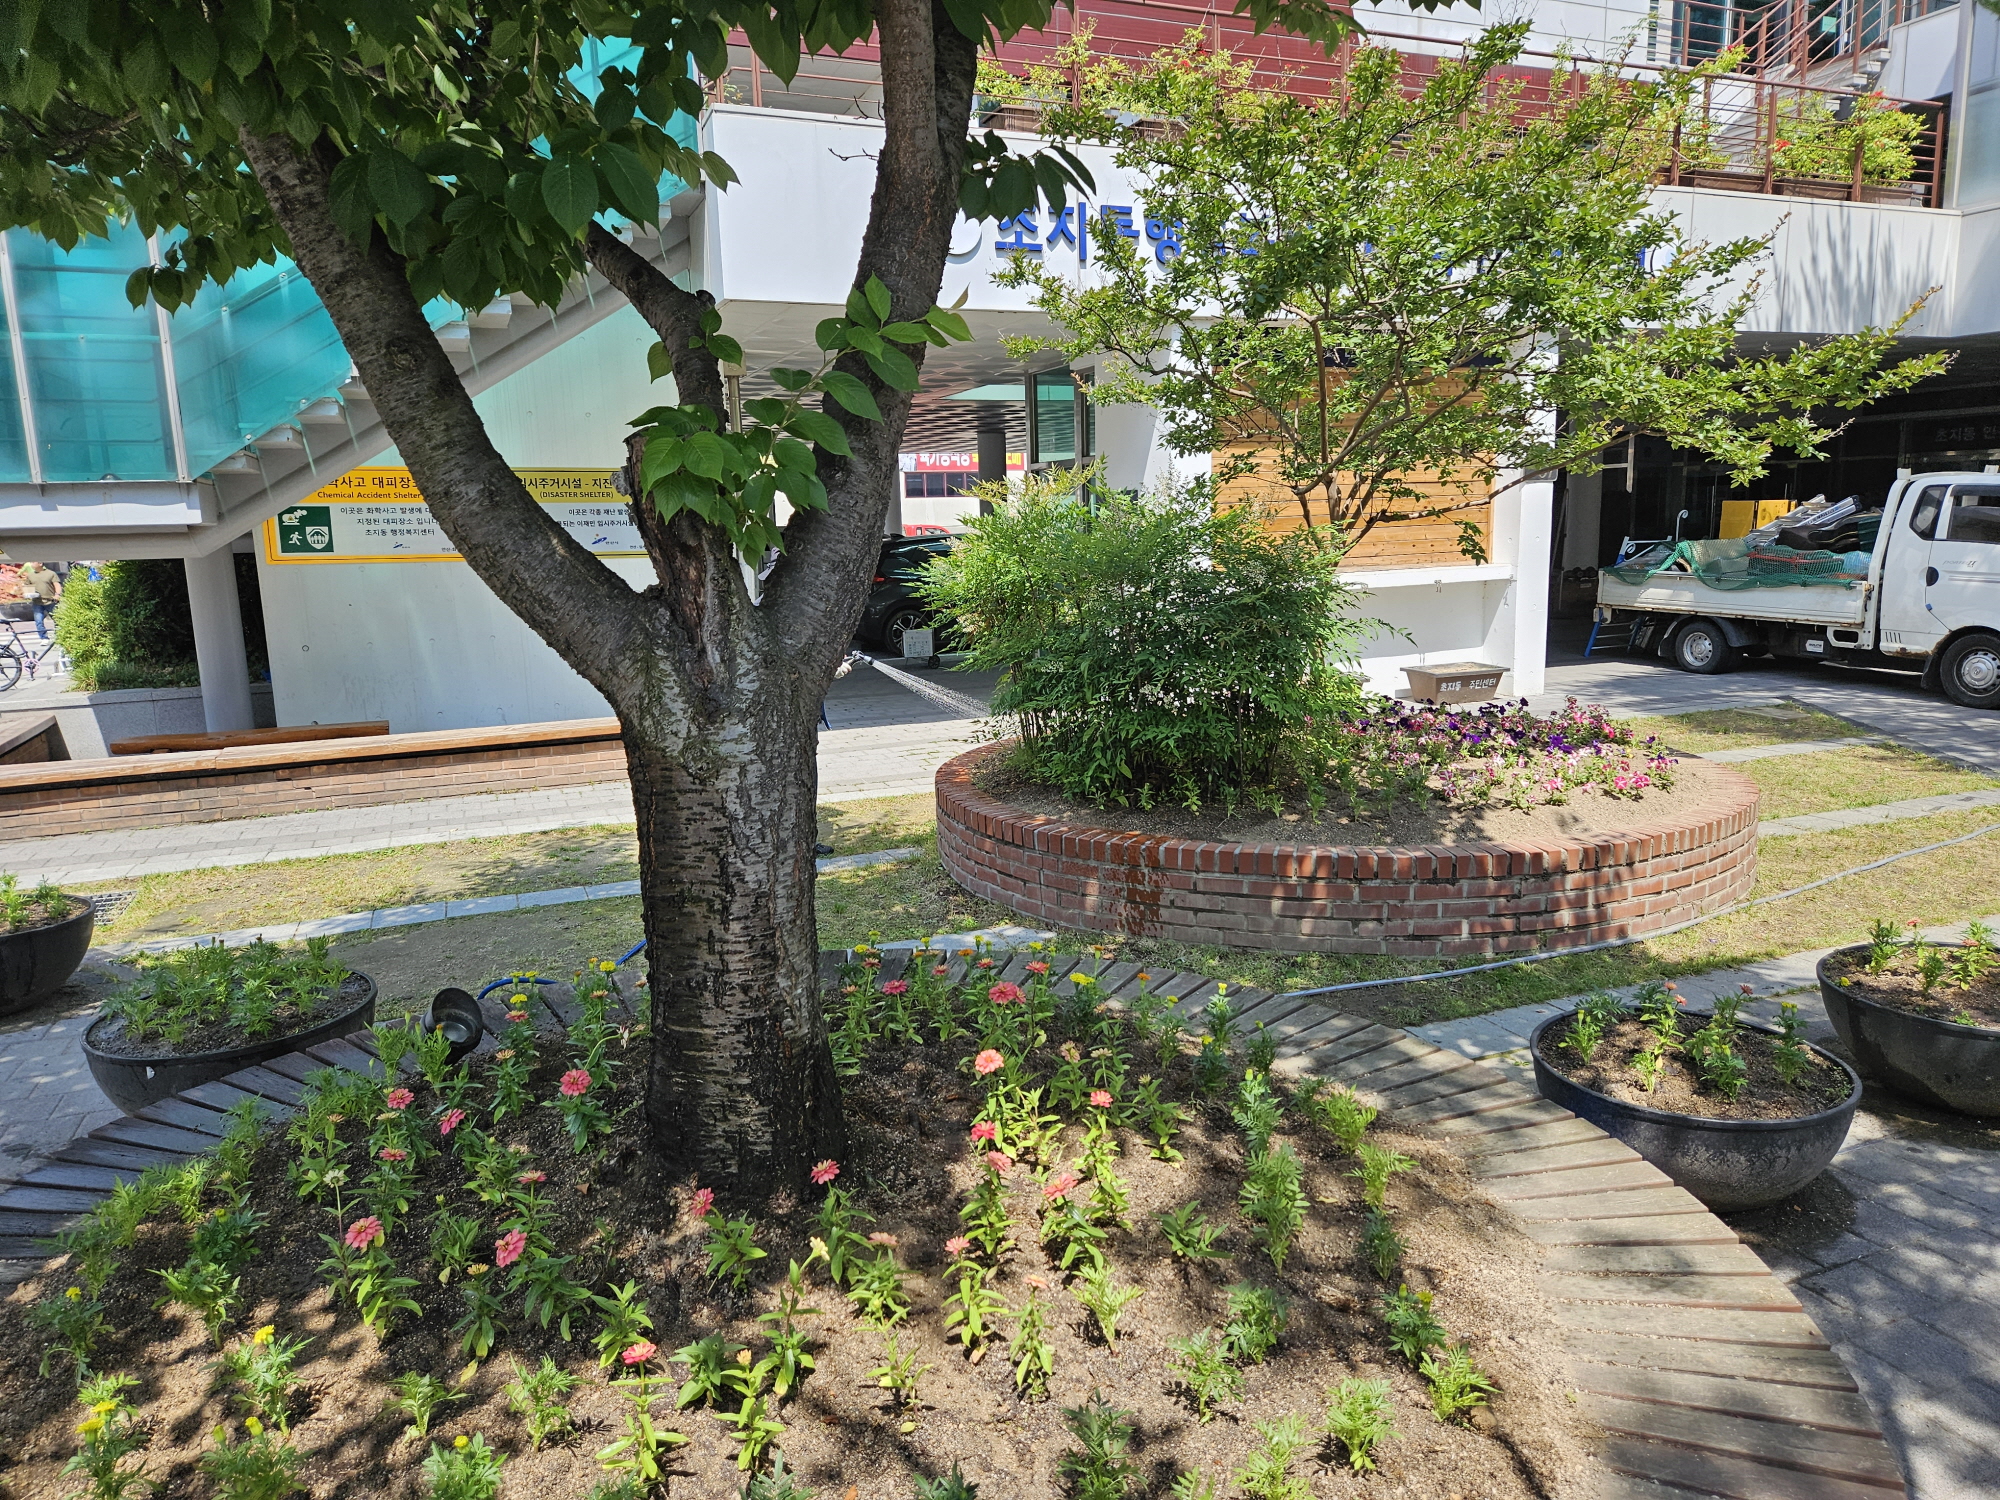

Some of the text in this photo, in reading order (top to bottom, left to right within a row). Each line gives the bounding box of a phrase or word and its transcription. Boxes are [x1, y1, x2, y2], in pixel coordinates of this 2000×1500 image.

[317, 491, 354, 499] Chemical
[357, 491, 391, 499] Accident
[540, 491, 614, 499] (DISASTER SHELTER)
[340, 507, 363, 515] 이곳은
[366, 507, 398, 515] 화학사고
[400, 507, 423, 515] 발생에
[568, 508, 588, 516] 이곳은
[603, 508, 616, 516] 재난
[357, 517, 380, 526] 지정된
[383, 517, 414, 526] 대피장소
[365, 528, 435, 536] 초지동 행정복지센터
[1440, 678, 1496, 692] 초지동 주민센터
